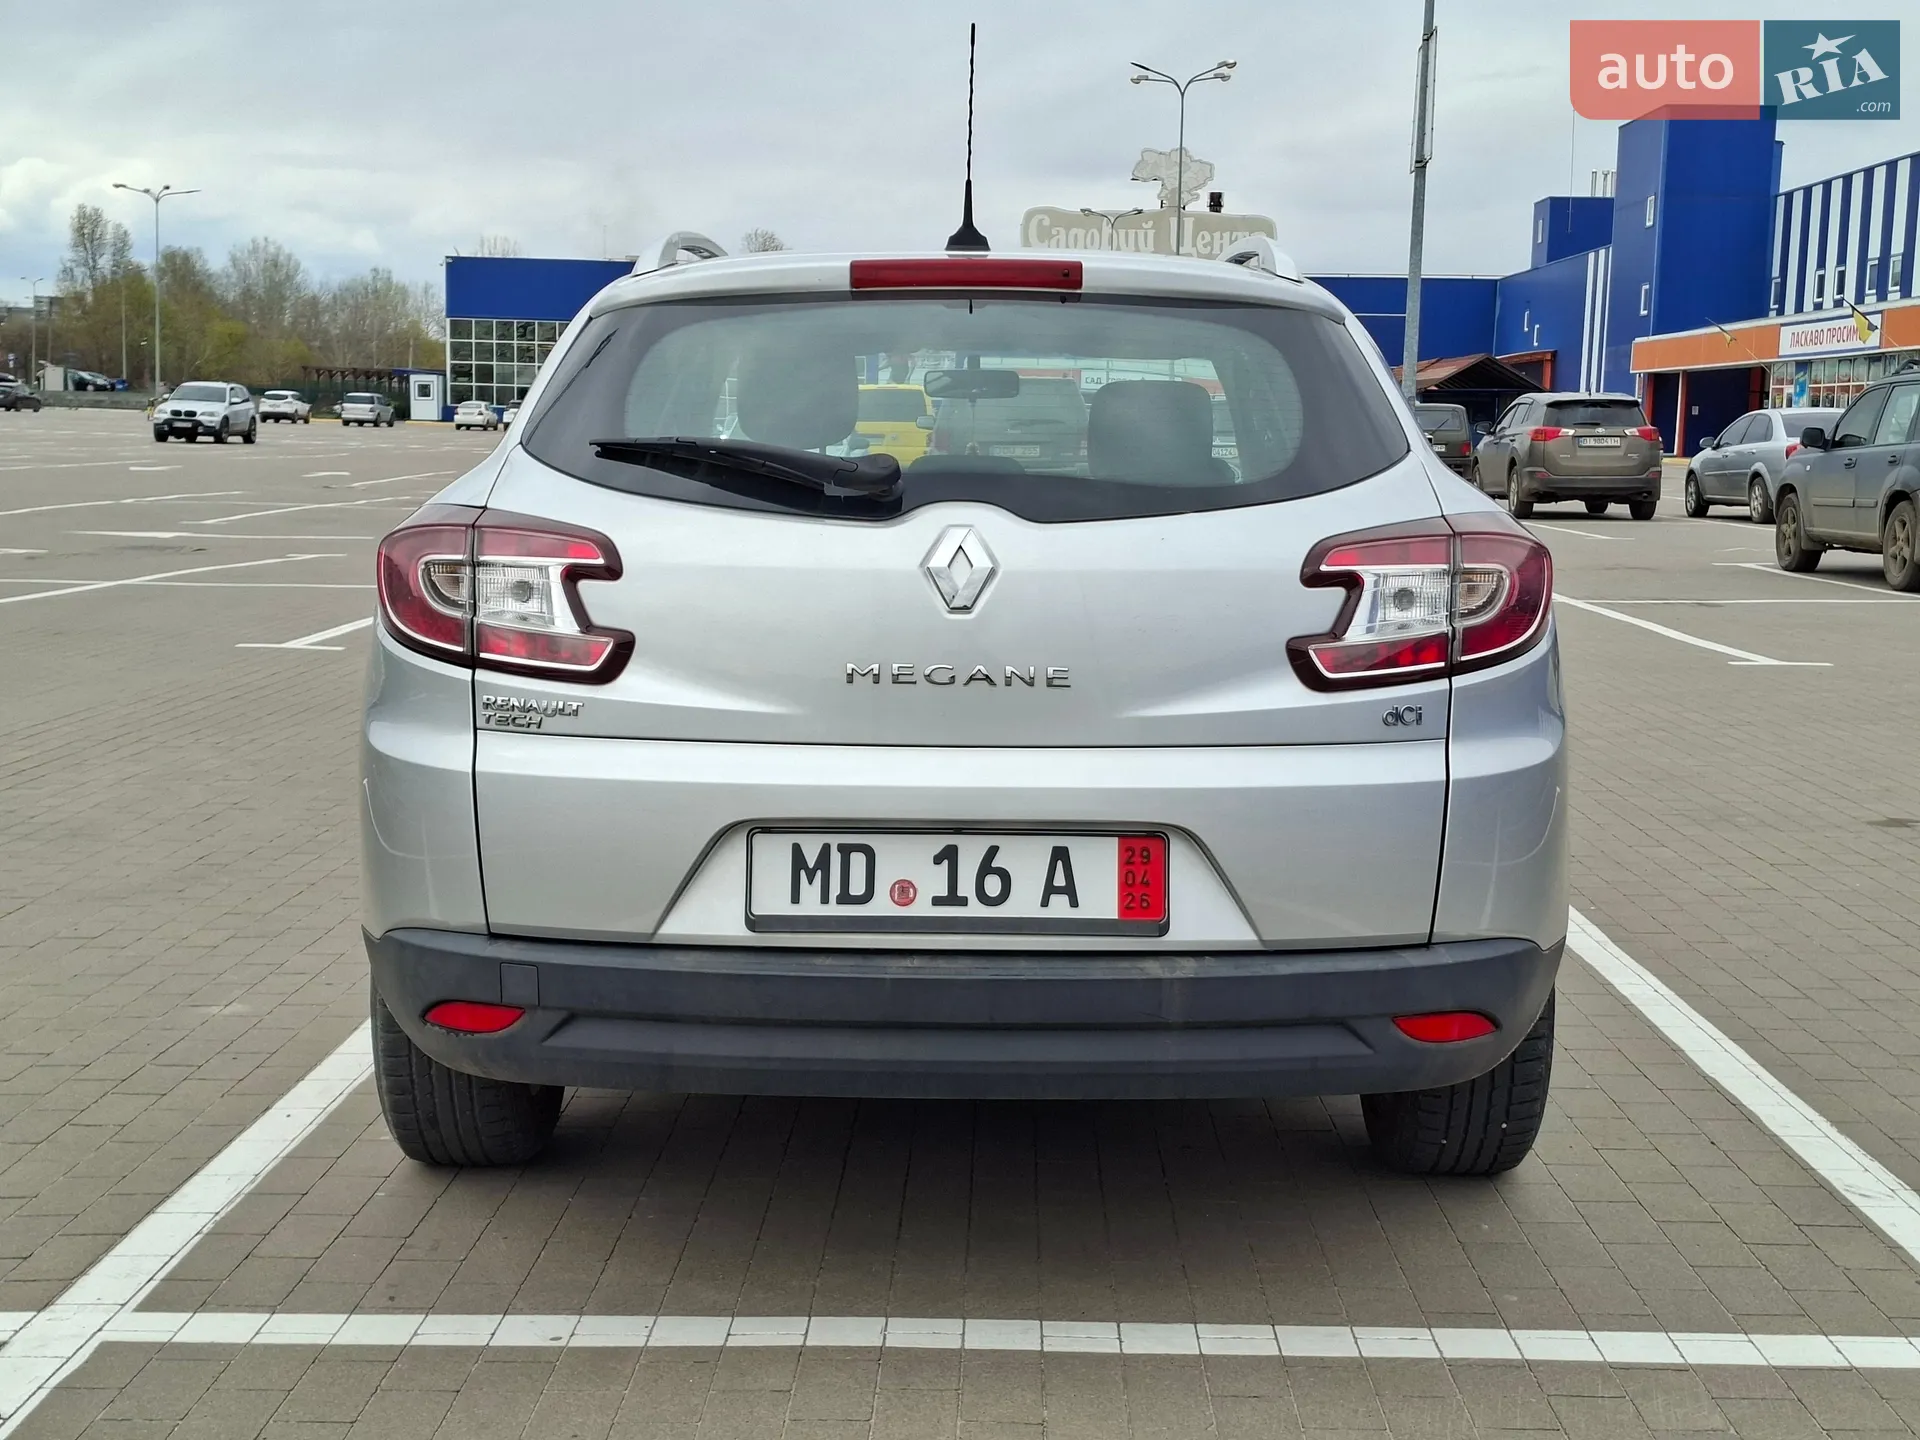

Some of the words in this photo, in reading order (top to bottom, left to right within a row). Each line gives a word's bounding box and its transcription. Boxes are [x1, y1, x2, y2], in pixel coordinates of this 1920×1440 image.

[1790, 328, 1825, 349] ЛАСКАВО
[846, 662, 1071, 688] MEGANE
[482, 695, 584, 717] RENAULT
[1382, 704, 1423, 727] dCi
[482, 711, 543, 729] TECH
[1124, 845, 1151, 866] 29
[790, 842, 876, 905] MD
[931, 844, 1011, 907] 16
[1040, 845, 1080, 908] A
[1124, 869, 1151, 888] 04
[1123, 892, 1151, 911] 26
